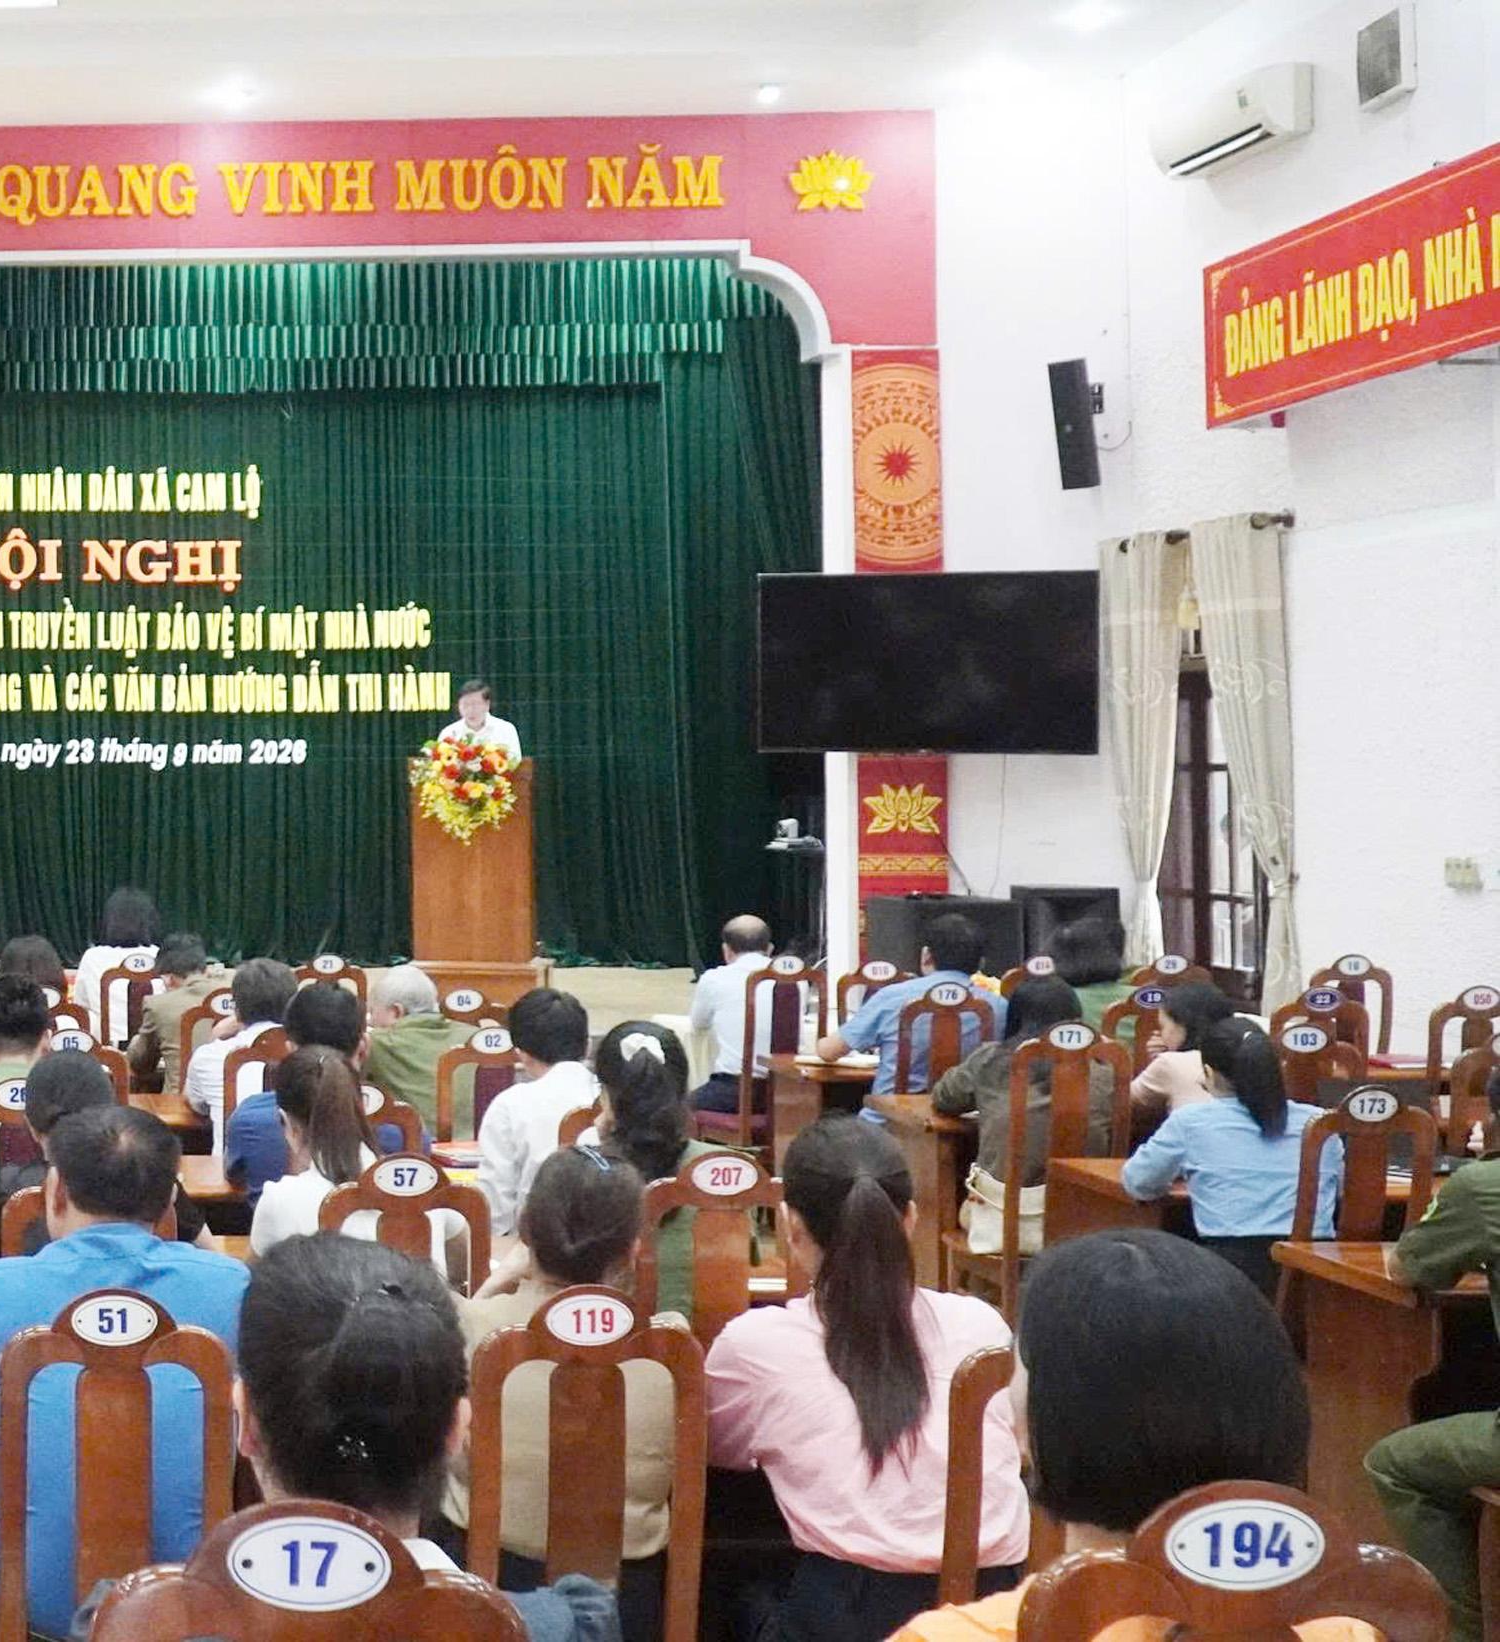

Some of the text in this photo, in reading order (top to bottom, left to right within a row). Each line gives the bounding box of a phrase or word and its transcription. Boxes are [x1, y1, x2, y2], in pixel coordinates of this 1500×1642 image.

[221, 160, 373, 215] VINH
[397, 145, 566, 213] MUÔN
[588, 144, 724, 209] NĂM
[1224, 287, 1284, 378] ĐẢNG
[1289, 270, 1352, 356] LÃNH
[1357, 249, 1417, 342] ĐẠO,
[1423, 206, 1484, 311] NHÀ
[21, 466, 82, 512] NHÂN
[89, 466, 133, 512] DÂN
[176, 472, 226, 512] CAM
[233, 464, 260, 518] LỘ
[82, 539, 242, 592] NGHỊ
[9, 596, 91, 650] TRUYỀN
[97, 604, 150, 658] LUẬT
[157, 602, 200, 650] BẢO
[206, 605, 234, 659] VỆ
[241, 605, 265, 650] BÍ
[269, 605, 318, 659] MẬT
[324, 602, 371, 650] NHÀ
[373, 600, 431, 650] NƯỚC
[30, 664, 57, 711] VÀ
[65, 664, 107, 712] CÁC
[113, 665, 156, 712] VĂN
[161, 662, 207, 712] BẢN
[213, 665, 287, 713] HƯỚNG
[346, 673, 382, 712] THI
[388, 664, 451, 712] HÀNH
[0, 739, 61, 770] ngày
[65, 738, 95, 765] 23
[100, 737, 168, 771] tháng
[192, 740, 242, 764] năm
[938, 989, 958, 1000] 176
[485, 1034, 501, 1047] 02
[1059, 1031, 1082, 1044] 171
[1294, 1033, 1317, 1046] 103
[1360, 1098, 1386, 1114] 173
[394, 1168, 417, 1186] 57
[711, 1167, 742, 1186] 207
[99, 1308, 126, 1333] 51
[573, 1308, 613, 1333] 119
[1204, 1522, 1293, 1568] 194
[282, 1541, 337, 1587] 17
